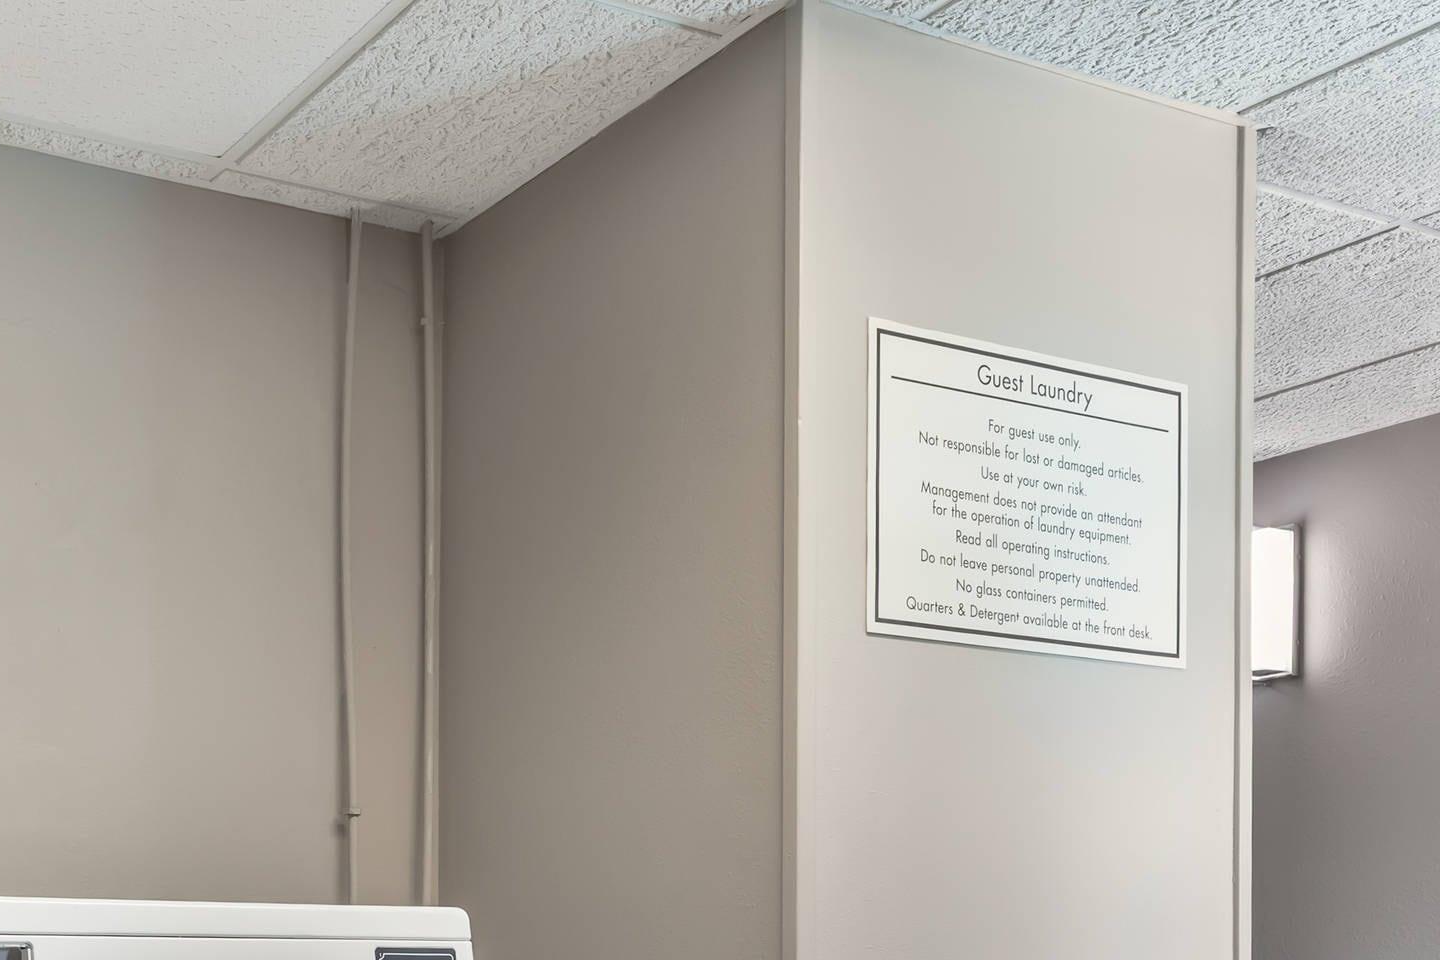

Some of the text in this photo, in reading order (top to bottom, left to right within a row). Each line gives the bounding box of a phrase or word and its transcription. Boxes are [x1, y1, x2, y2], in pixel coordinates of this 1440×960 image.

[977, 364, 1093, 412] Guest Laundry
[988, 419, 1081, 452] For guest use only.
[919, 431, 1144, 483] Not responsible for lost or damaged articles.
[981, 467, 1087, 496] Use at your own risk.
[921, 481, 1142, 528] Management does not provide an attendant
[932, 500, 1131, 546] for the operation of laundry equipment.
[956, 530, 1110, 565] Read all operating instructions.
[921, 549, 1140, 592] Do not leave personal property unattended.
[956, 579, 1108, 612] No glass containers permitted.
[906, 597, 1152, 639] Quarters & Detergent available at the front desk.
